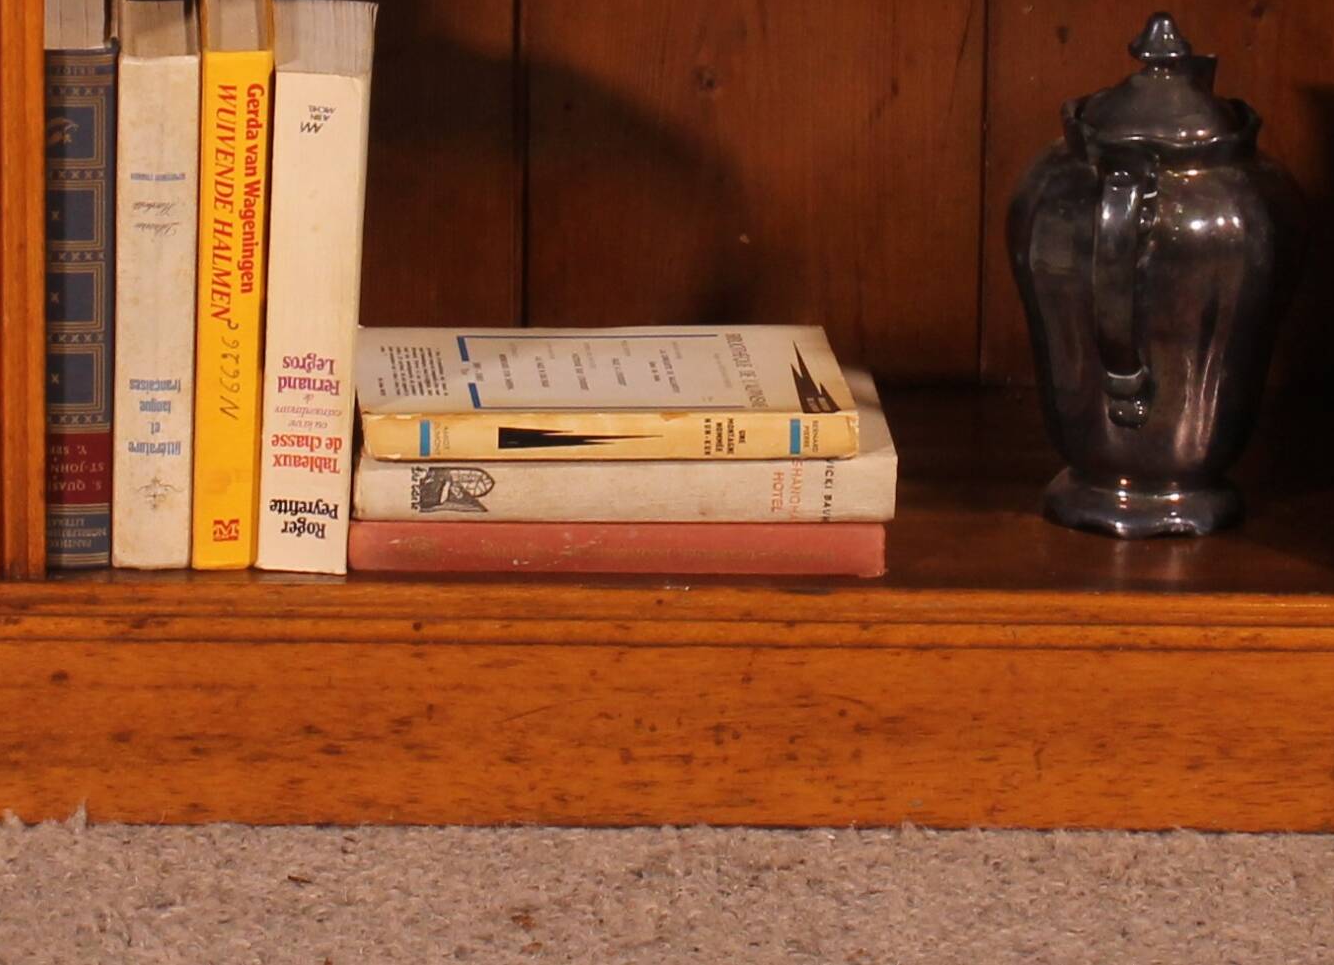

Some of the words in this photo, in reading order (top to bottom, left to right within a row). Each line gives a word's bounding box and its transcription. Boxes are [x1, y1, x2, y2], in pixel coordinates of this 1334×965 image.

[246, 82, 266, 140] Gerda
[213, 83, 238, 214] WUIVENDE
[243, 143, 260, 177] van
[237, 180, 262, 295] Wageningen
[210, 217, 234, 325] HALMEN
[282, 352, 336, 375] Legros
[277, 376, 341, 397] Fernand
[139, 397, 171, 415] langue
[150, 421, 161, 436] et
[727, 418, 735, 455] MONTAGNE
[812, 420, 820, 454] BERNARD
[271, 434, 322, 453] chasse
[324, 436, 343, 454] de
[272, 454, 341, 475] Tableaux
[770, 471, 785, 514] HOTEL
[268, 498, 339, 520] Peyrefitte
[281, 516, 326, 540] Roger
